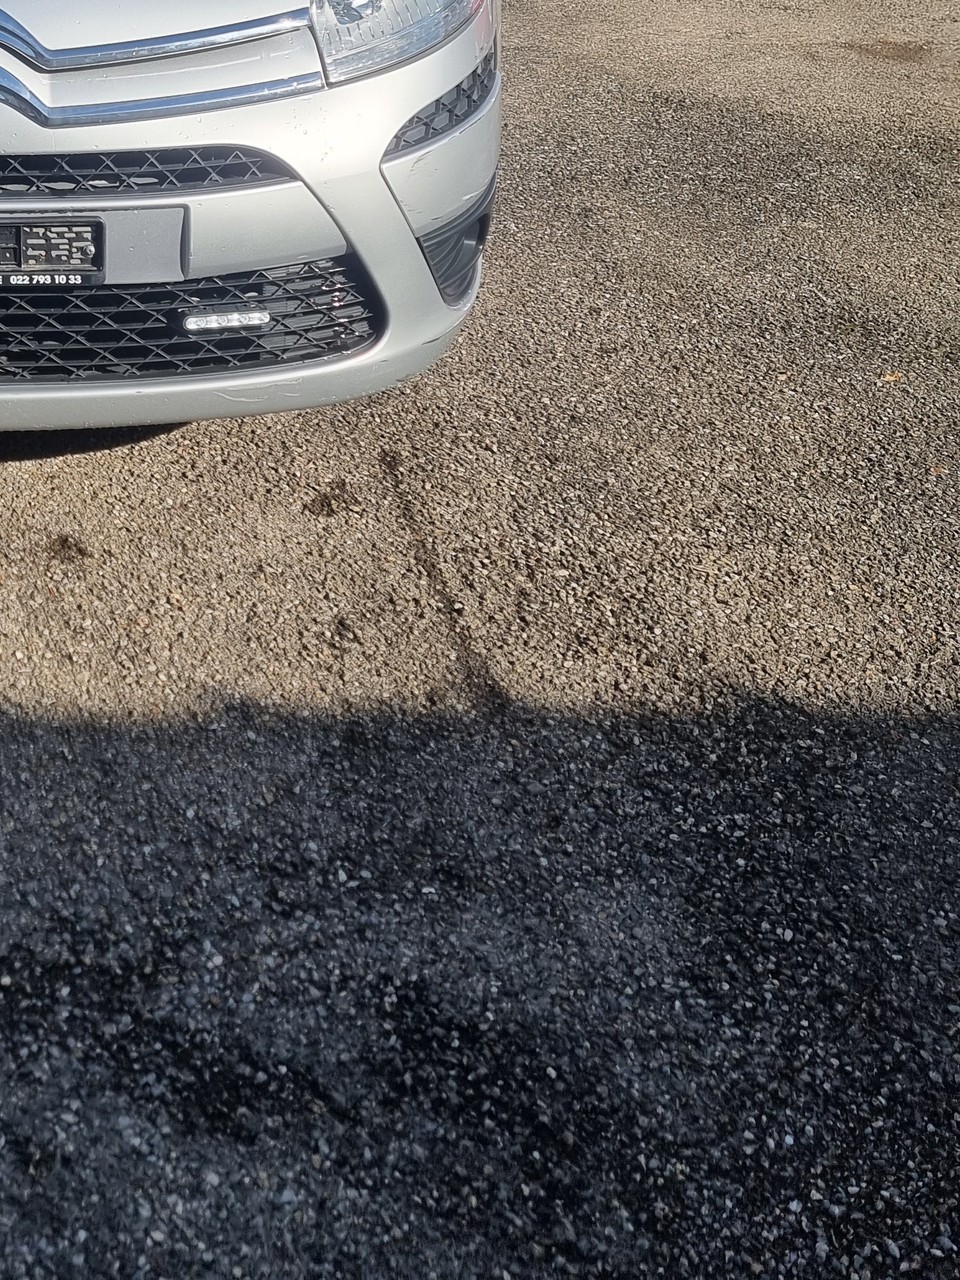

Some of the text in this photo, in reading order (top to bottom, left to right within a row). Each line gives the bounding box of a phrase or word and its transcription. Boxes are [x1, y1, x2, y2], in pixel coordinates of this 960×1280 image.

[9, 275, 30, 285] 022
[32, 274, 52, 284] 793
[53, 274, 67, 284] 10
[68, 274, 82, 284] 33
